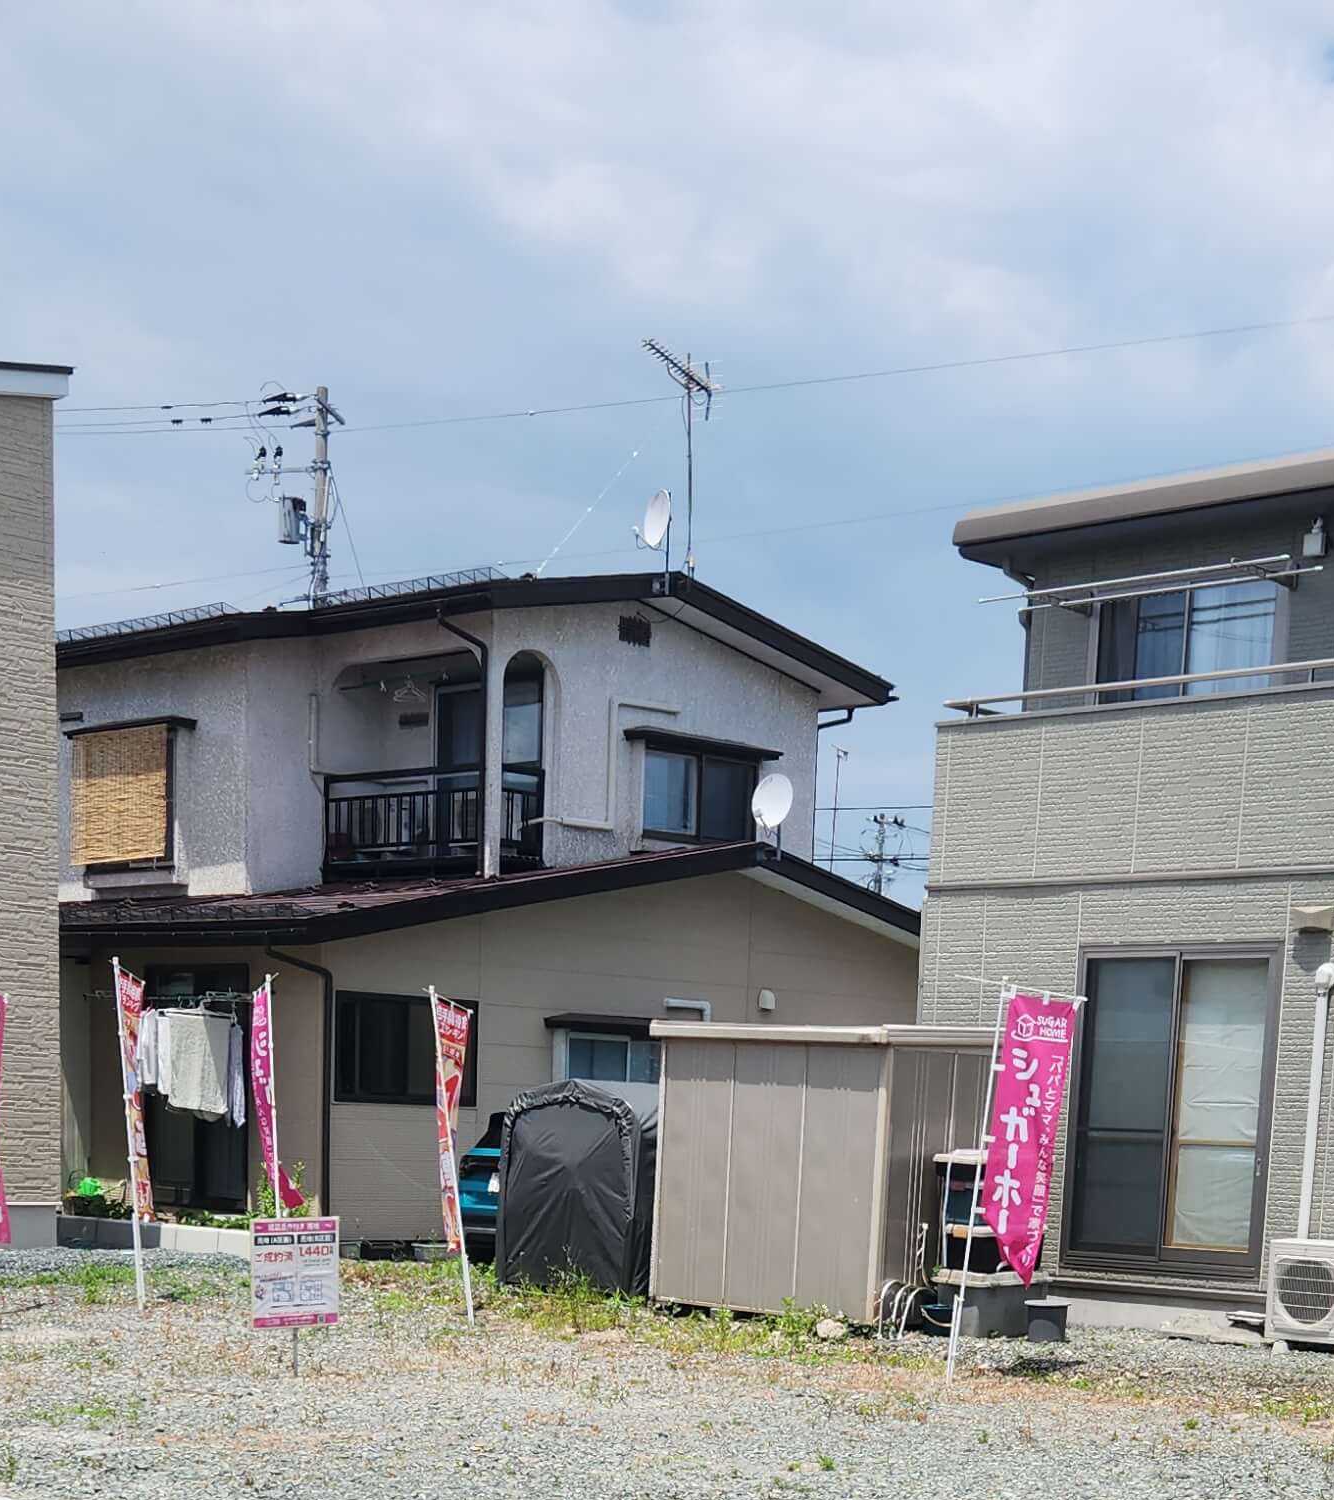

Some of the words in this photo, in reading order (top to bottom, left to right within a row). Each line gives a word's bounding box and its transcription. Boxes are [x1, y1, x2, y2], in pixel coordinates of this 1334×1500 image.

[1036, 1015, 1068, 1028] SUGAR
[1039, 1027, 1068, 1039] HOME
[993, 1048, 1041, 1262] シュガーホー
